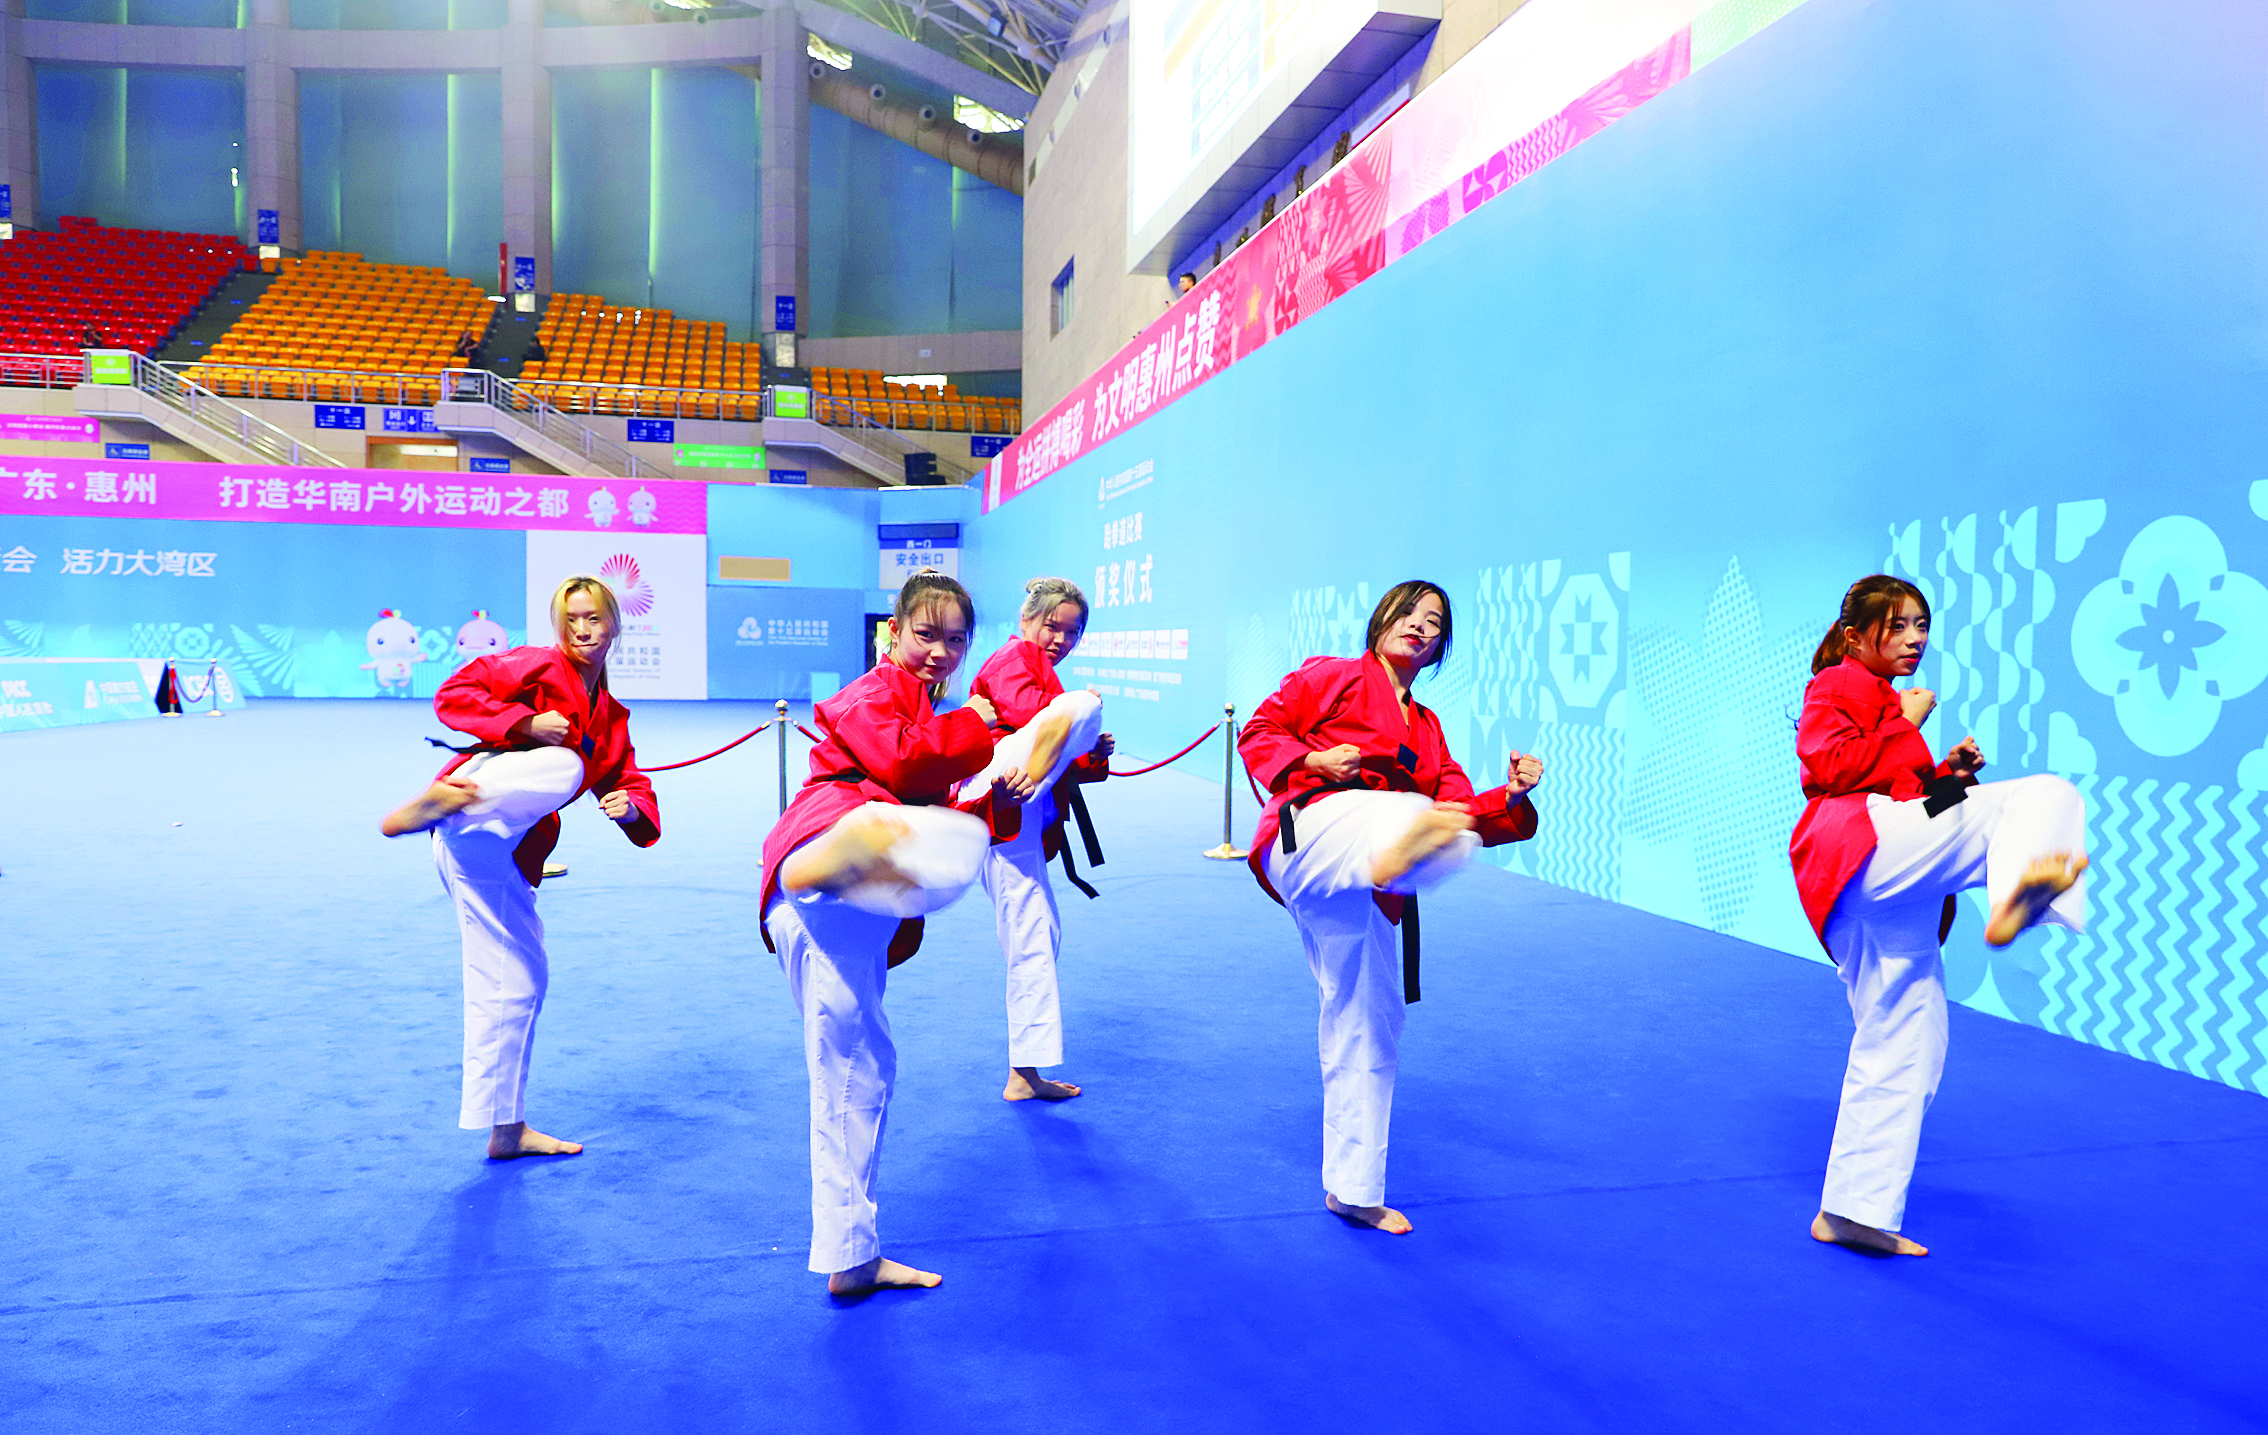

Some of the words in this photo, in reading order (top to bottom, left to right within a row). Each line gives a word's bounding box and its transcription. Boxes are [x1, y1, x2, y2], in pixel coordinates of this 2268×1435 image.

[1015, 398, 1085, 491] 为全运拼搏喝彩
[1091, 289, 1221, 442] 为文明惠州点赞
[219, 475, 570, 519] 打造华南户外运动之都
[1103, 512, 1143, 550] 跆拳道比赛
[0, 545, 38, 574] 会
[60, 548, 218, 577] 活力大湾区
[896, 553, 944, 566] 安全出口
[1094, 553, 1154, 609] 颁奖仪式
